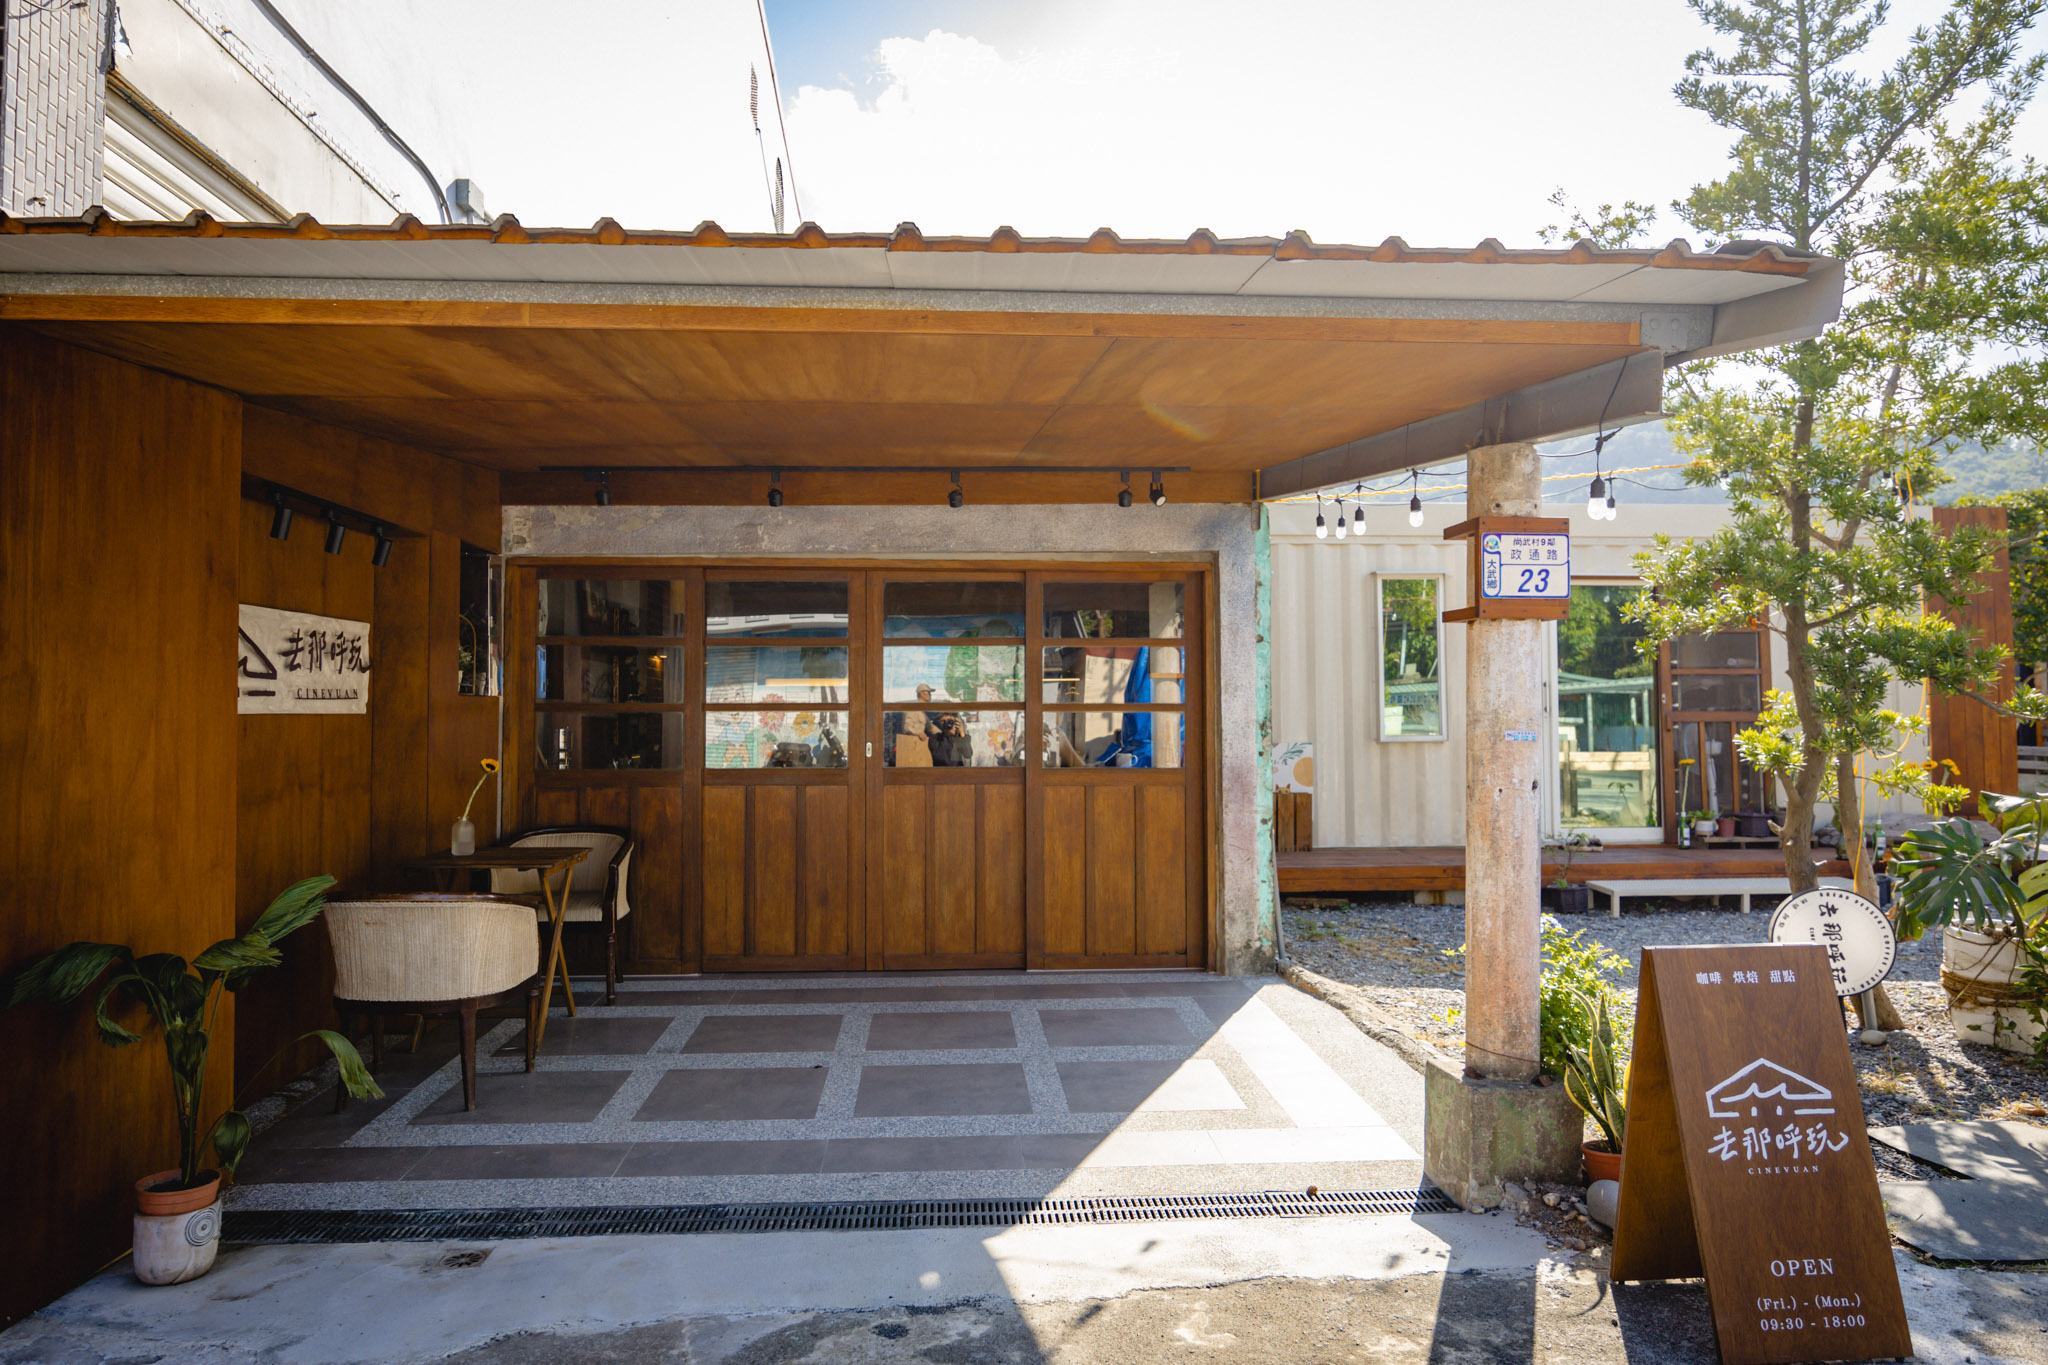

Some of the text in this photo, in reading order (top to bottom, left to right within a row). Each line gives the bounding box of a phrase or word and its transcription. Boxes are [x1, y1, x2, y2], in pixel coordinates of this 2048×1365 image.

[1511, 549, 1558, 561] 政通路
[1487, 559, 1497, 590] 大武鄉
[1518, 568, 1550, 593] 23
[1696, 969, 1796, 985] 咖啡 烘焙 甜點
[1770, 1258, 1834, 1277] OPEN
[1757, 1295, 1797, 1312] (Fri.)
[1815, 1292, 1861, 1310] (Mon.)
[1760, 1317, 1804, 1331] 09:30
[1823, 1314, 1865, 1328] 18:00
